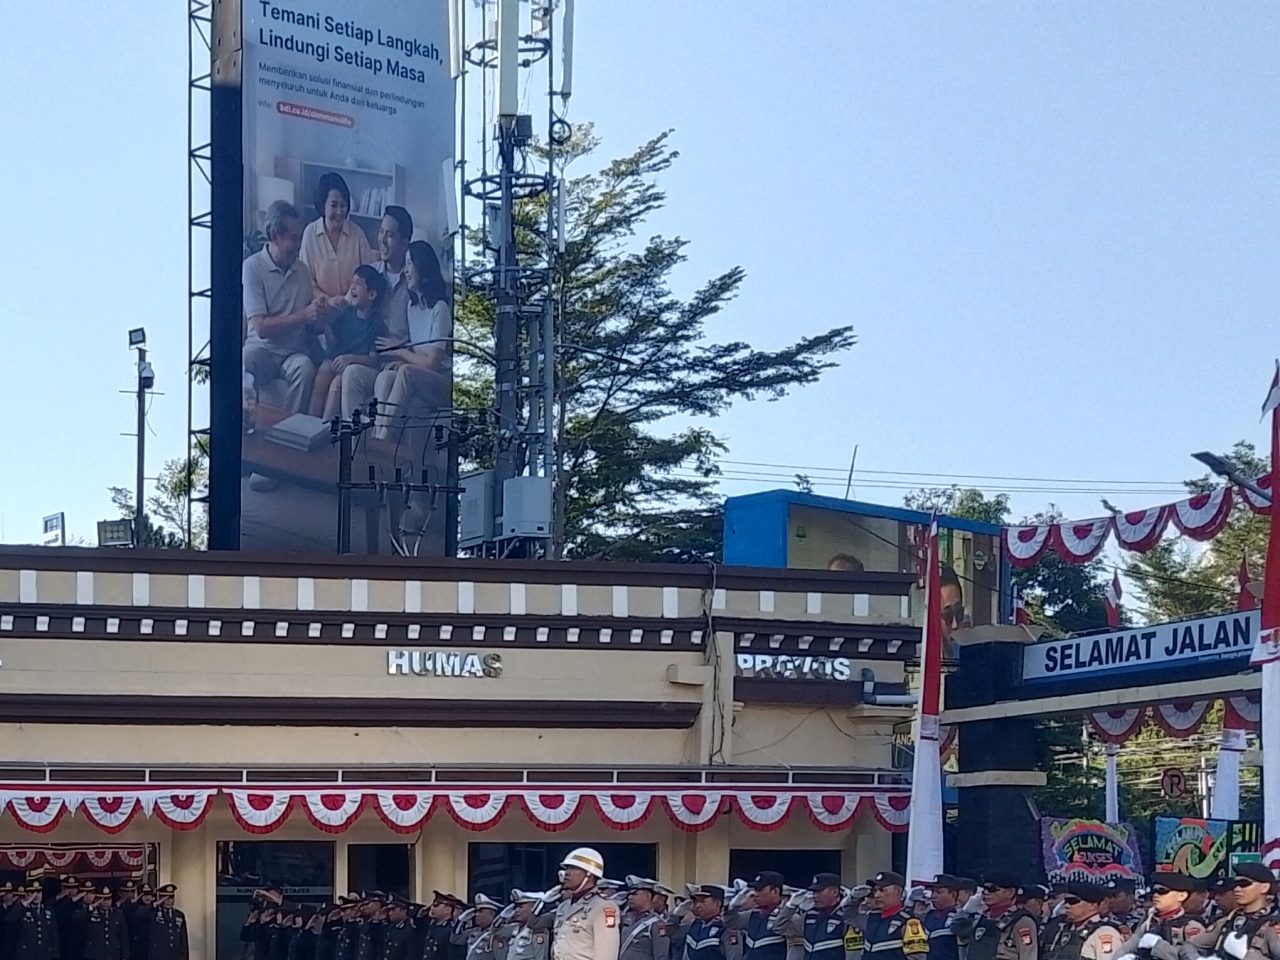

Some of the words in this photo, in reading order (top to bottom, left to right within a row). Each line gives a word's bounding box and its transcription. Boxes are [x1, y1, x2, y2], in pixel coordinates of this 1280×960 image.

[259, 0, 320, 30] Temani
[324, 16, 374, 46] Setiap
[377, 28, 444, 66] Langkah,
[259, 28, 330, 62] Lindungi
[334, 46, 383, 75] Setiap
[387, 58, 425, 83] Masa
[259, 62, 307, 81] Memberikan
[365, 87, 379, 98] dan
[380, 91, 425, 109] perlindungan
[306, 87, 329, 99] untuk
[330, 91, 349, 103] Anda
[367, 100, 397, 116] keluarga
[1044, 631, 1157, 673] SELAMAT
[1164, 616, 1251, 656] JALAN
[387, 650, 503, 678] HUMAS
[736, 653, 851, 681] PROVOS
[1063, 835, 1122, 858] SELAMAT
